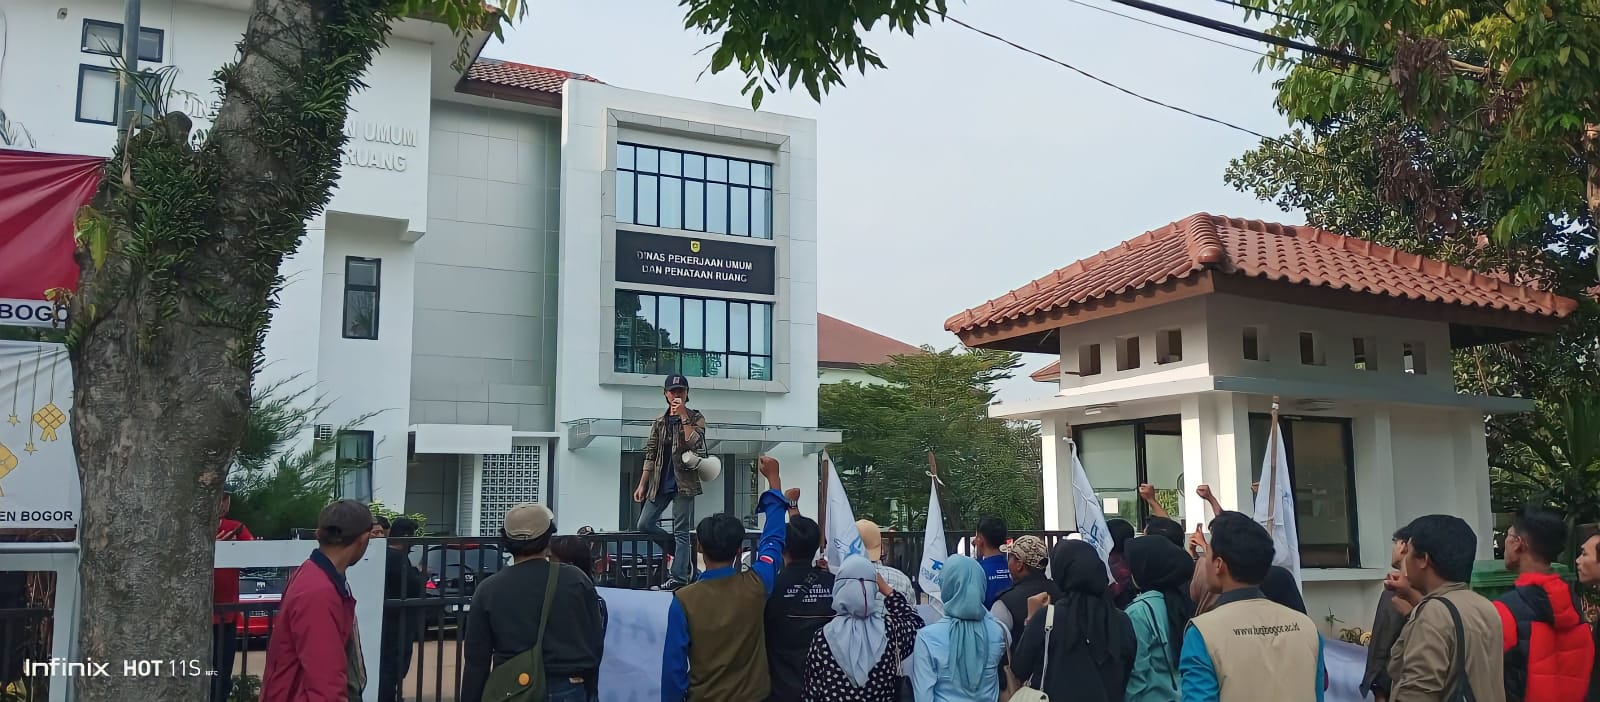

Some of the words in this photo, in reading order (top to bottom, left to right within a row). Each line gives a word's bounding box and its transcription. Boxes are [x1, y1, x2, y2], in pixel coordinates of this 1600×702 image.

[363, 120, 418, 147] UMUM
[637, 251, 665, 262] DINAS
[668, 254, 723, 268] PEKERJAAN
[726, 260, 752, 270] UMUM
[642, 265, 661, 275] DAN
[665, 267, 713, 279] PENATAAN
[716, 272, 747, 282] RUANG
[0, 304, 69, 321] BOGO
[21, 511, 73, 521] BOGOR
